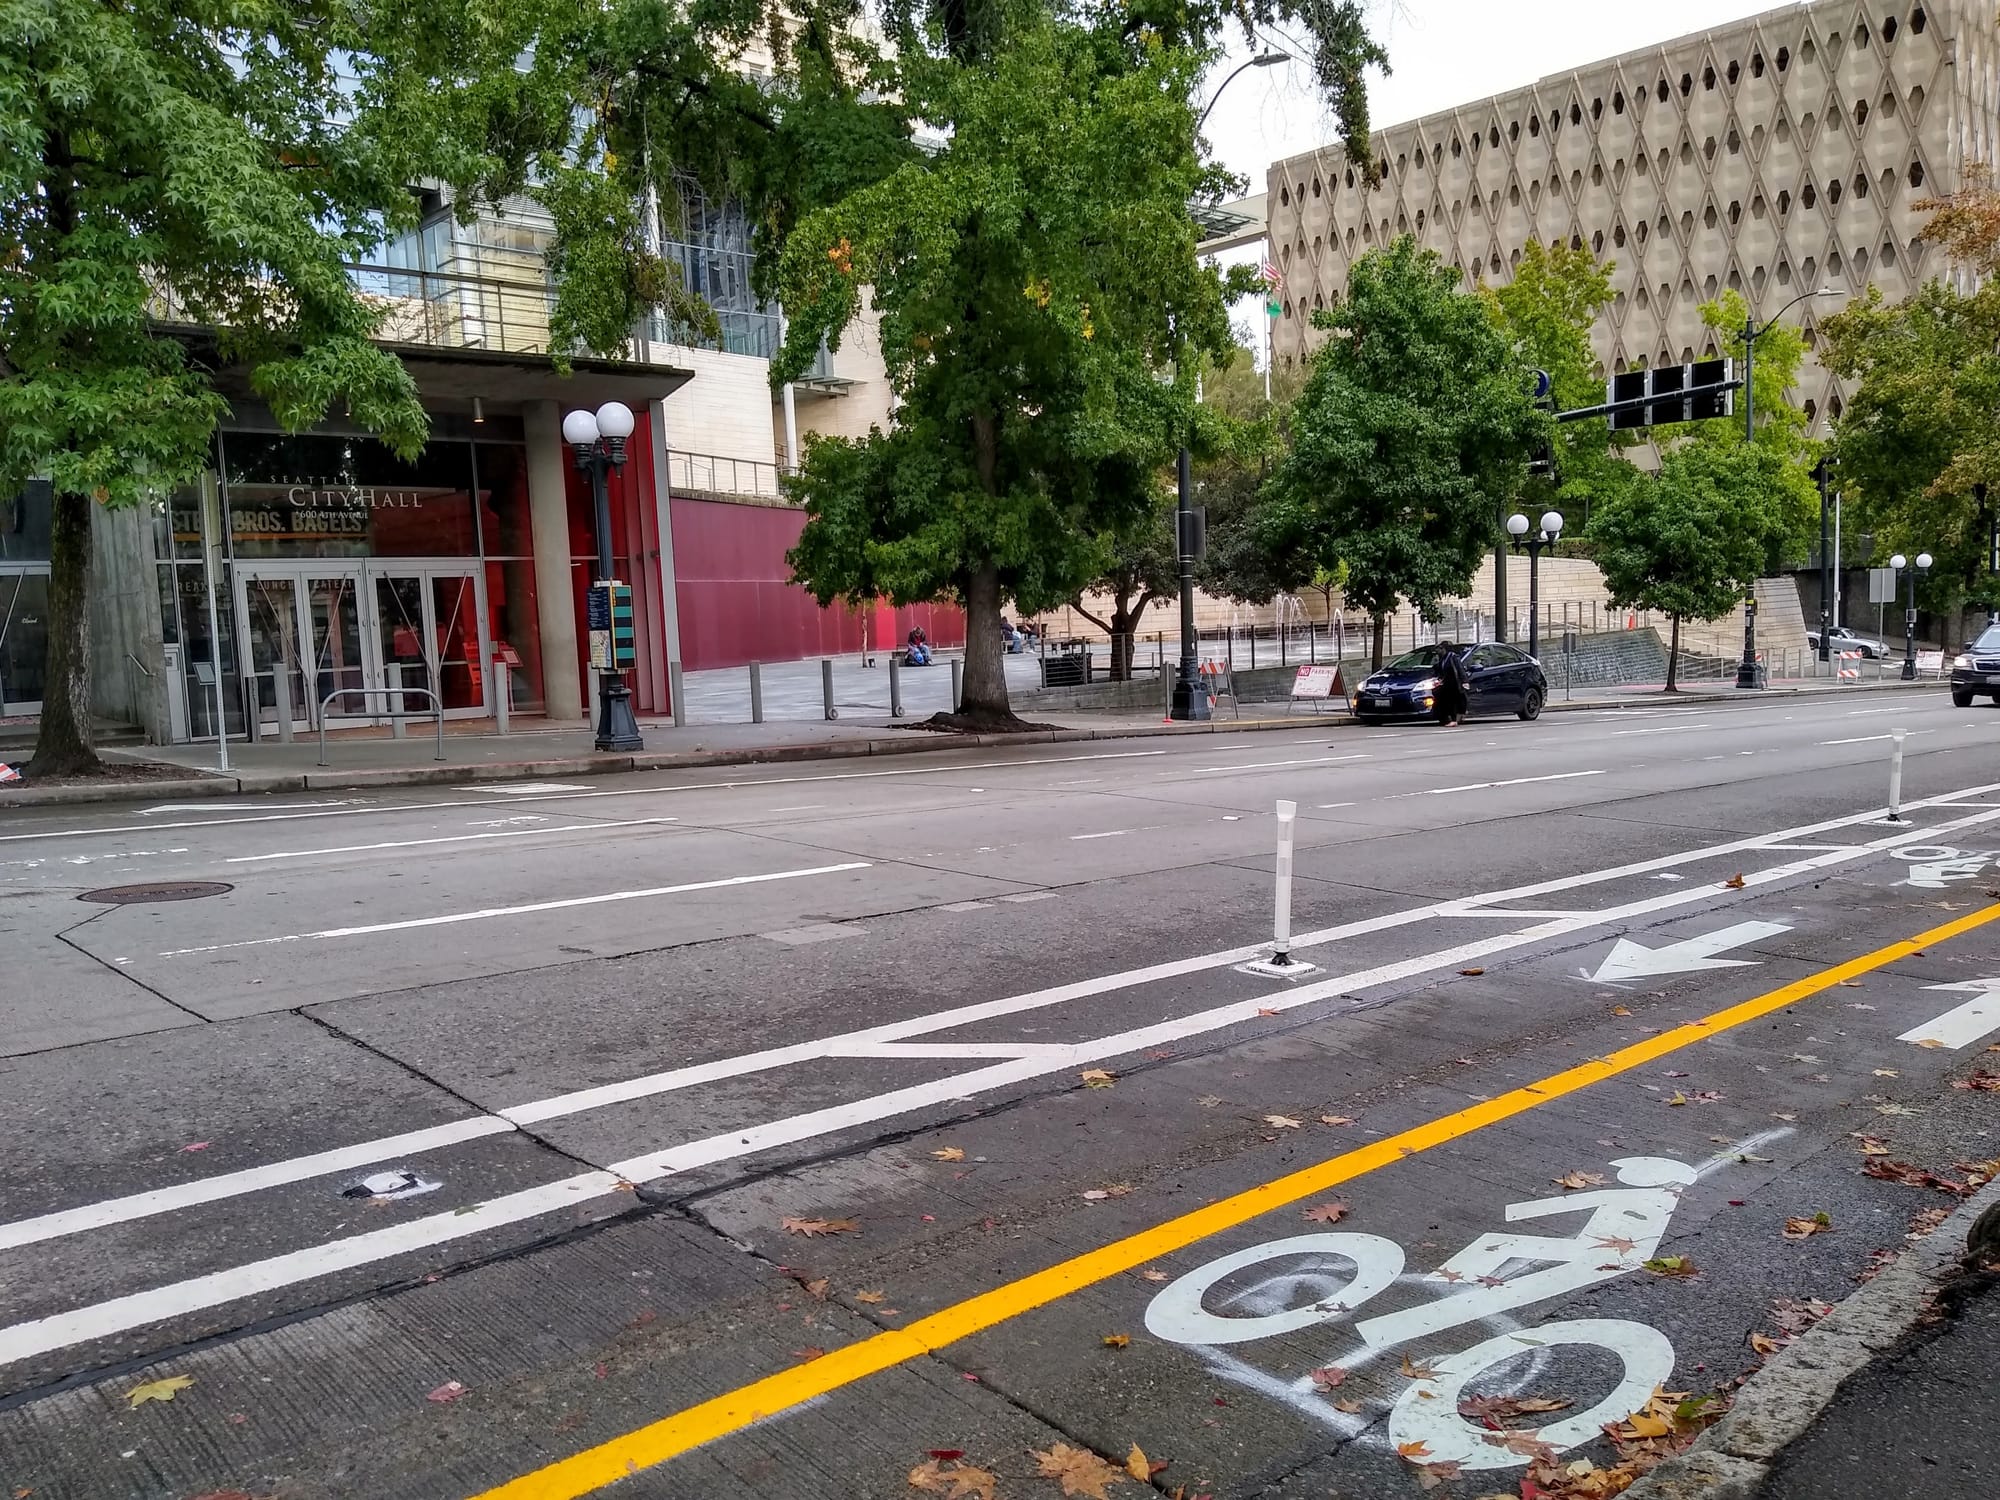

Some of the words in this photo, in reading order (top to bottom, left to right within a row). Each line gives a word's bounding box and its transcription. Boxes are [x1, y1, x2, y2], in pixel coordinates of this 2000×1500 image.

[270, 475, 351, 485] SEATTLE
[288, 487, 351, 507] CITY
[359, 488, 423, 508] HALL
[233, 510, 287, 533] BROS.
[291, 510, 363, 533] BAGELS
[300, 510, 317, 519] 600
